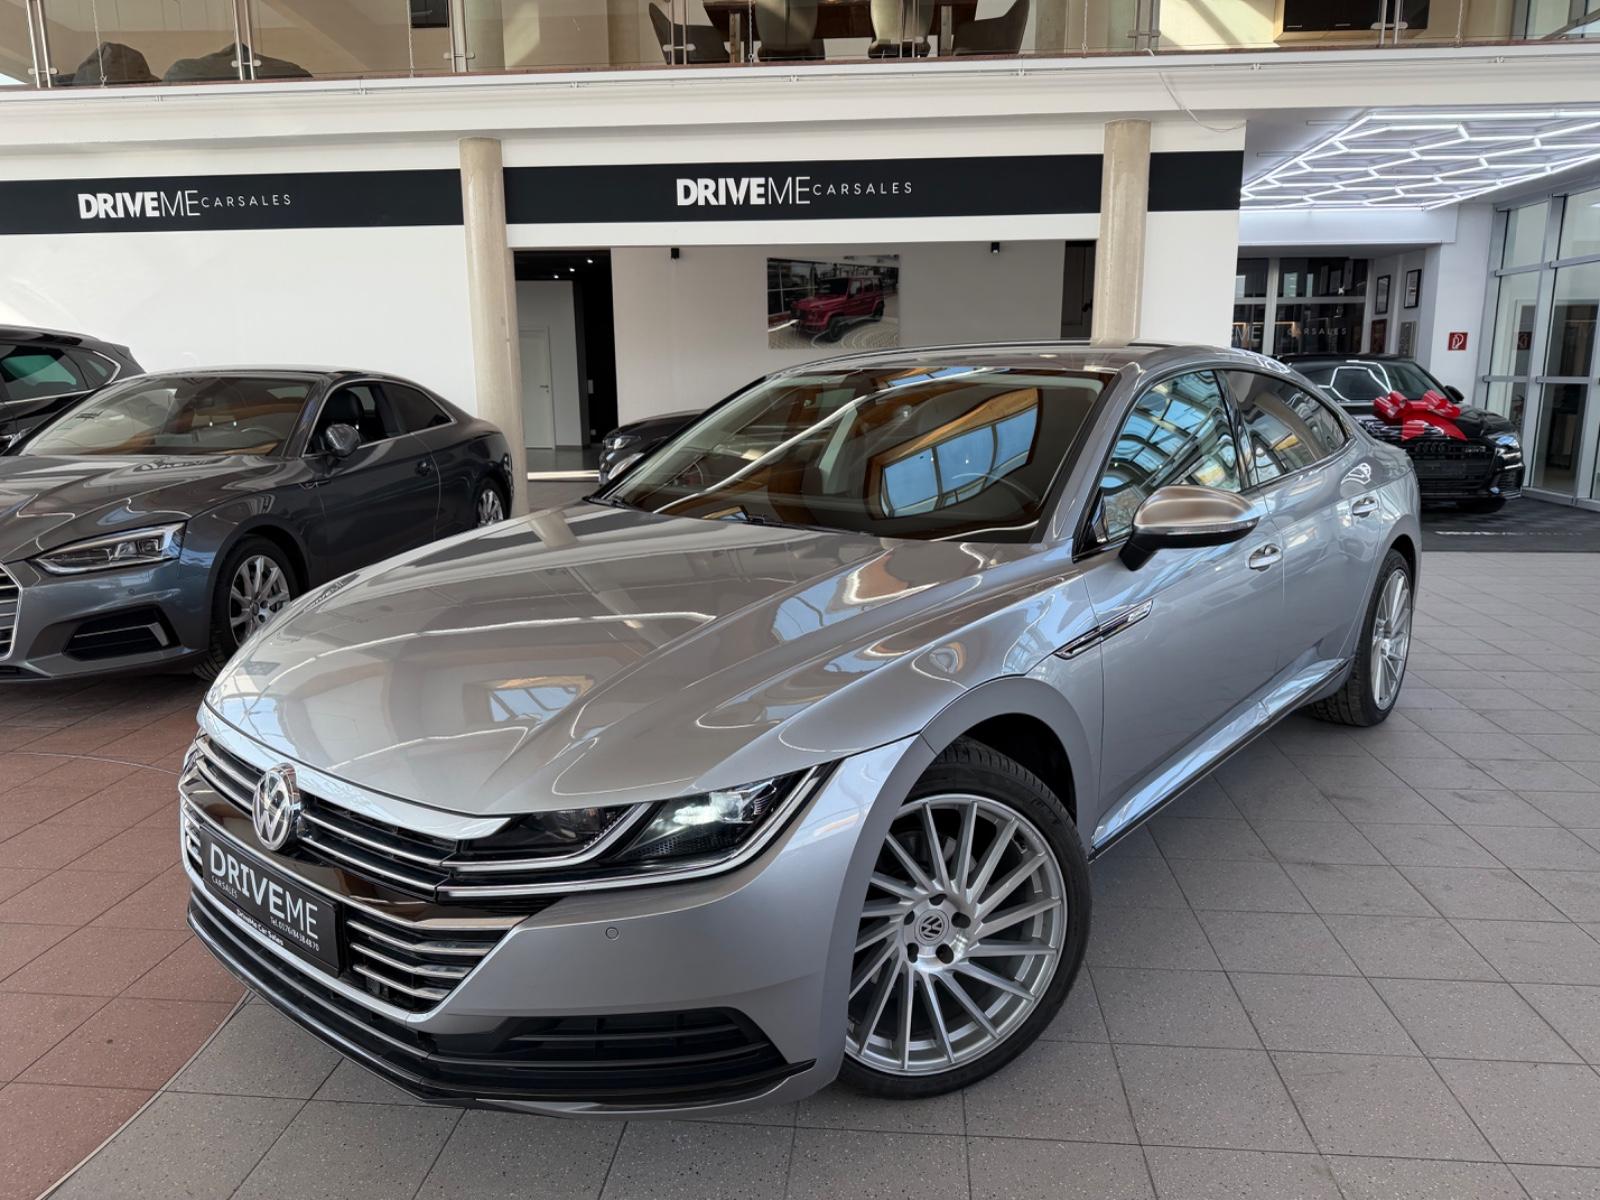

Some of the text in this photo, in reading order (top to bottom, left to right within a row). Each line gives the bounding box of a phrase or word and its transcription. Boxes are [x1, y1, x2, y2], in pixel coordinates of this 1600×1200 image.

[77, 189, 291, 219] DRIVEME CARSALES
[676, 176, 912, 206] DRIVEME CARSALES
[210, 842, 319, 940] DRIVEME
